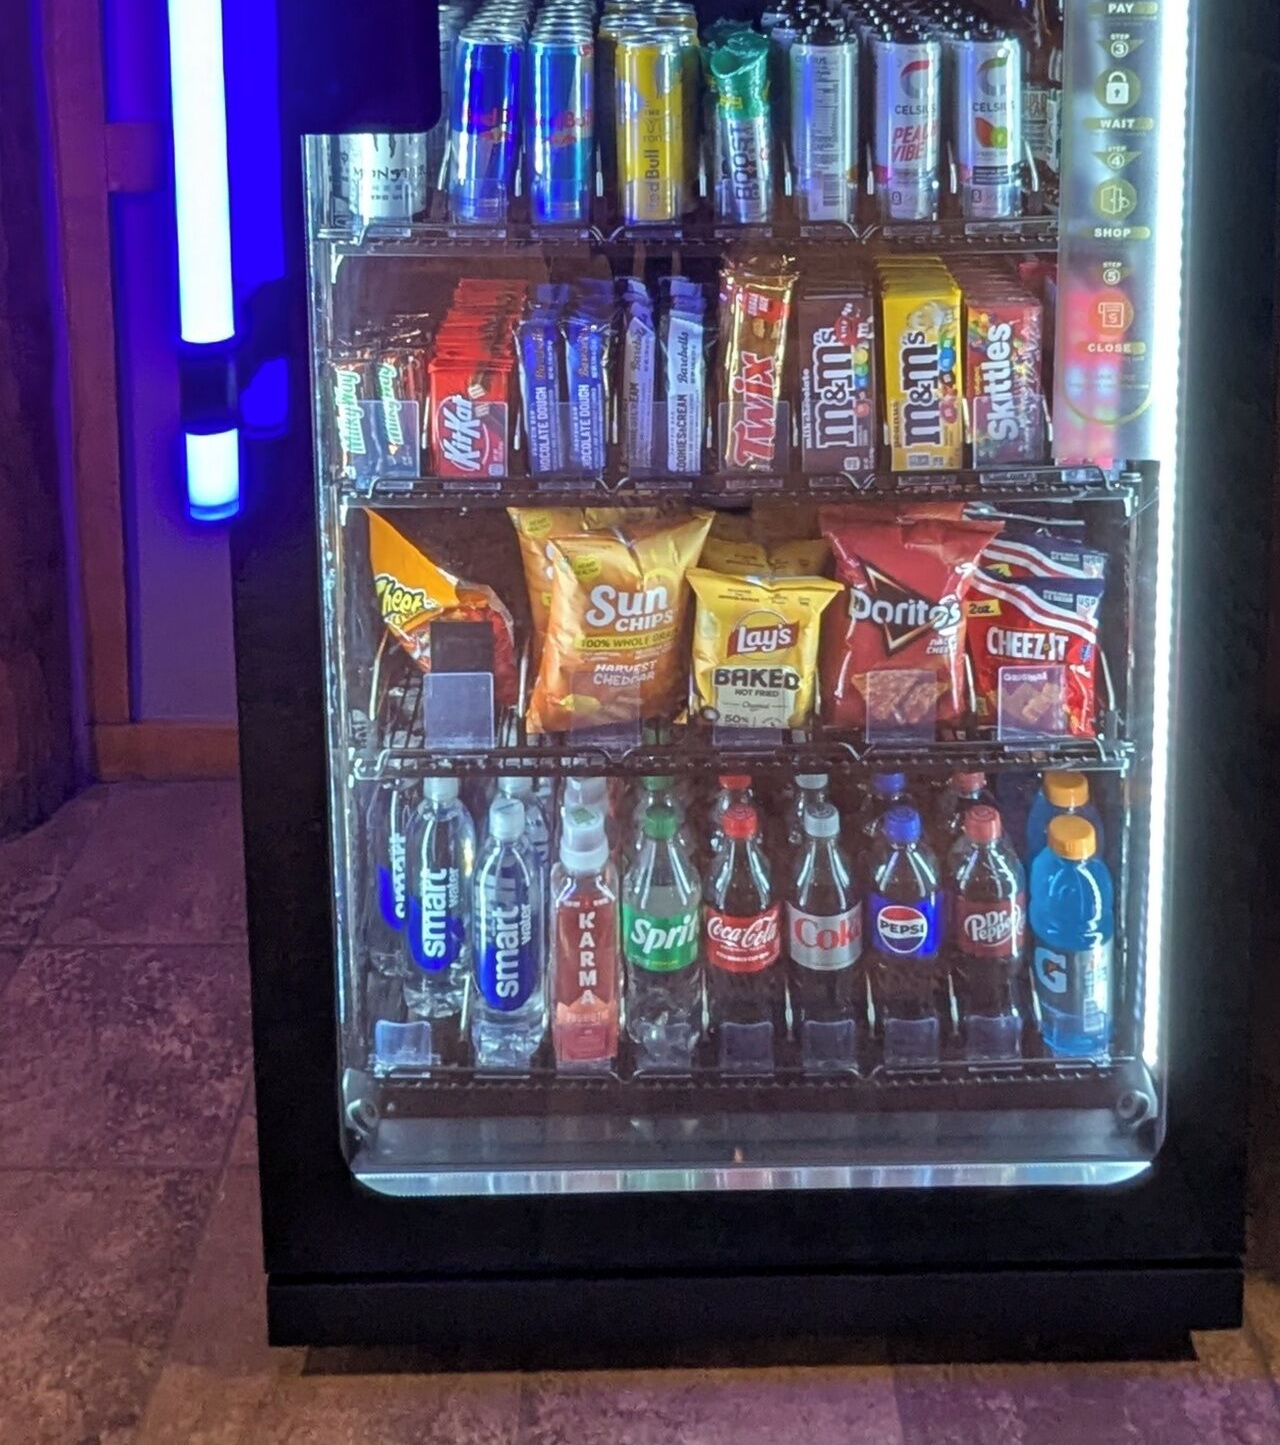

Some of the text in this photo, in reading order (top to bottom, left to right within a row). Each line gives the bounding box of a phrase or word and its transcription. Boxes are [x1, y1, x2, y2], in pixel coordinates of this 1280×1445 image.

[1108, 2, 1135, 14] PAY
[1115, 44, 1124, 55] 3
[972, 101, 1015, 113] CELSIS
[1100, 118, 1135, 129] WAIT
[644, 149, 660, 179] Bull
[1111, 155, 1121, 166] 4
[1094, 227, 1132, 238] SHOP
[1107, 270, 1116, 282] 5
[676, 331, 690, 384] Barebells
[1087, 343, 1132, 353] CLOSE
[535, 386, 548, 420] DOUGH
[578, 384, 591, 417] DOUGH
[803, 368, 812, 419] chocolate
[585, 584, 668, 627] Sun
[849, 586, 962, 631] Doritos
[615, 609, 674, 633] CHIPS
[581, 638, 611, 648] 100%
[613, 636, 650, 648] WHOLE
[737, 623, 792, 653] Lay's
[594, 659, 658, 674] HARVEST
[714, 668, 801, 690] BAKED
[735, 688, 779, 697] NOT FRIED
[447, 867, 460, 908] water
[421, 867, 447, 958] smart
[519, 904, 532, 946] water
[630, 910, 699, 955] Sprit
[706, 909, 779, 949] Coca-Cola
[879, 919, 925, 934] PEPSI
[492, 905, 520, 998] smart
